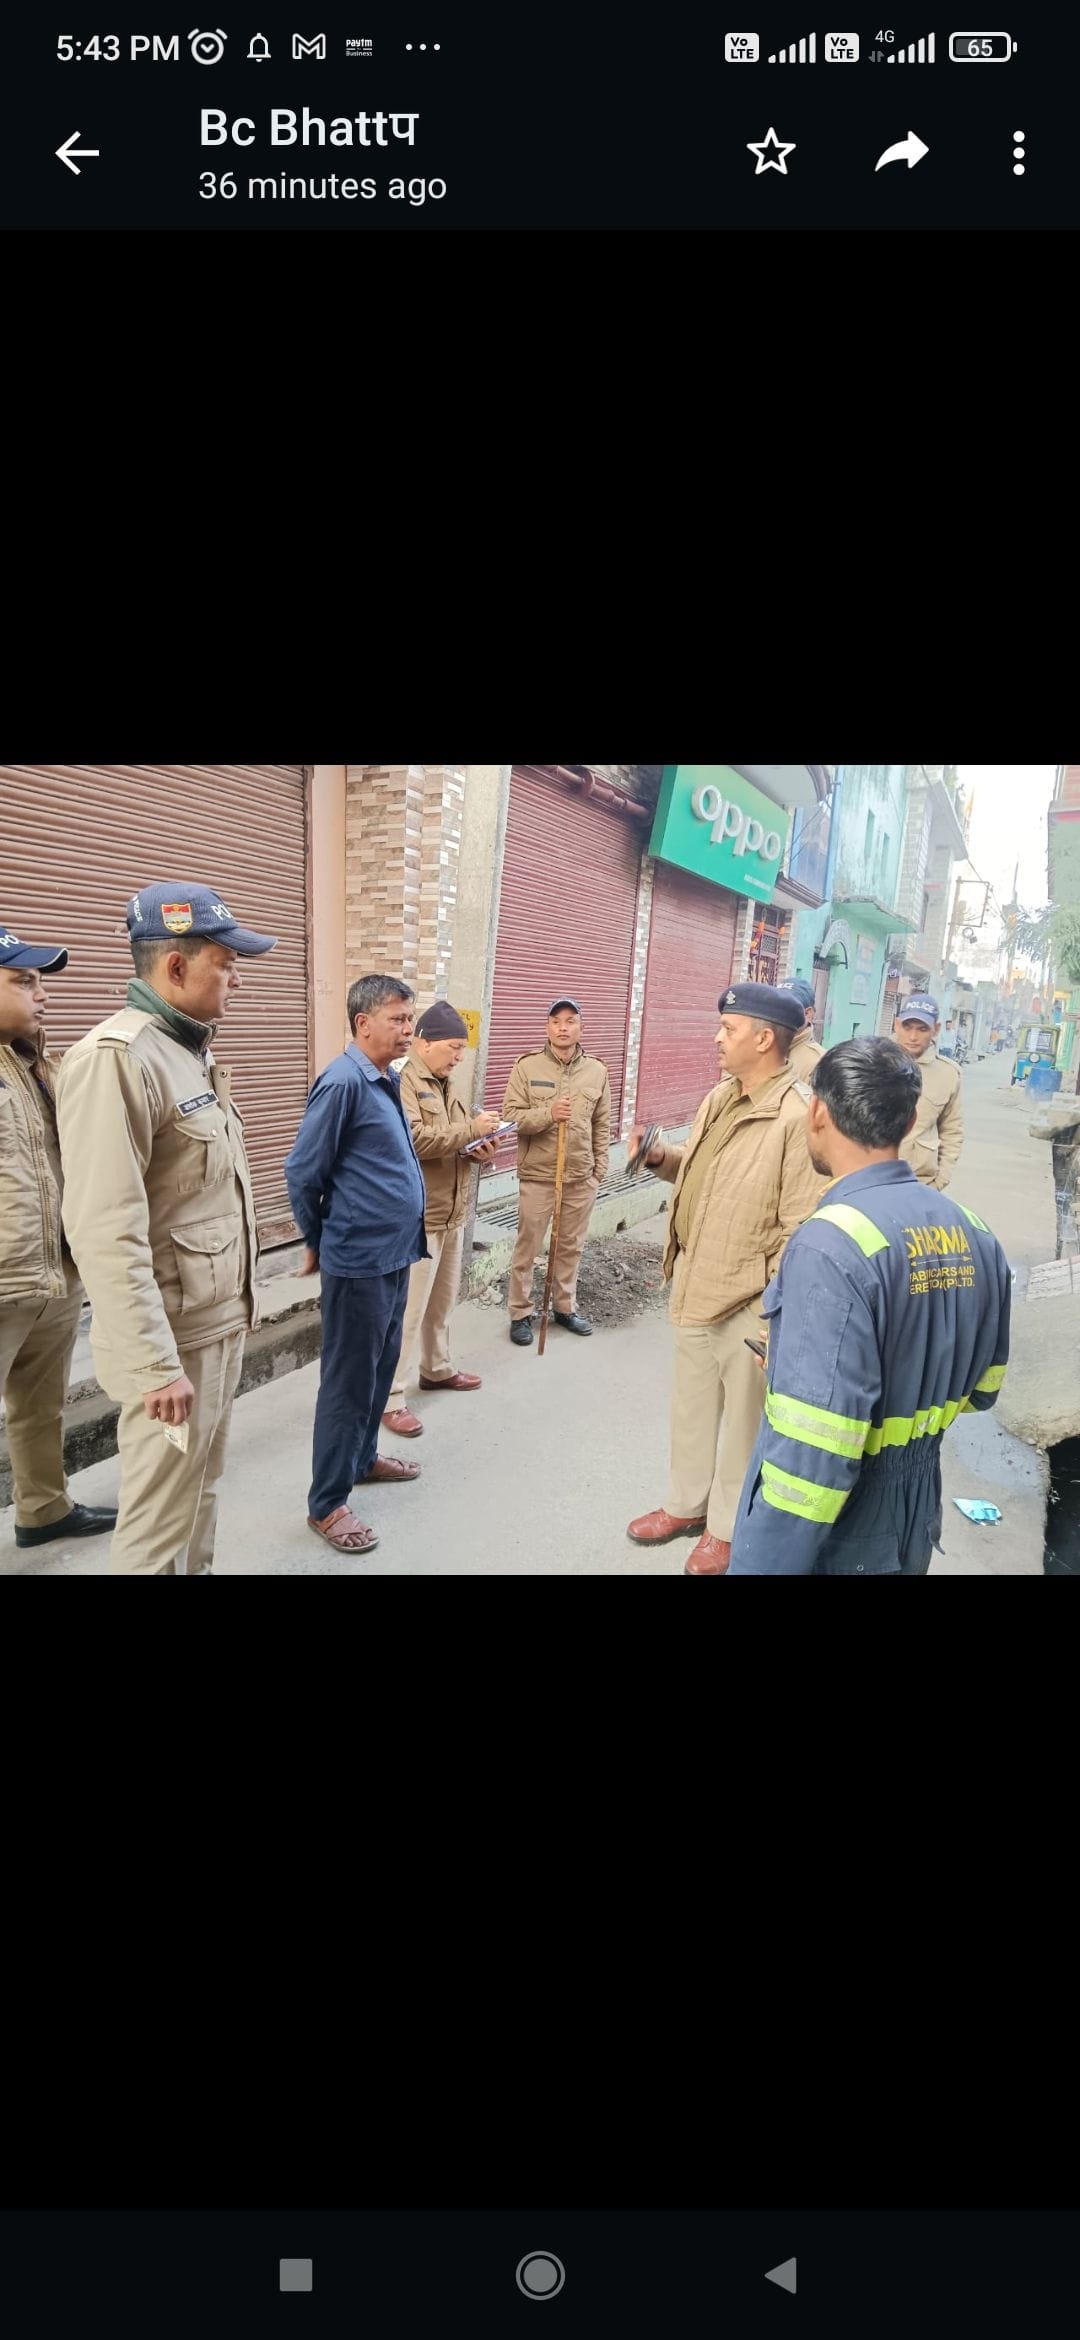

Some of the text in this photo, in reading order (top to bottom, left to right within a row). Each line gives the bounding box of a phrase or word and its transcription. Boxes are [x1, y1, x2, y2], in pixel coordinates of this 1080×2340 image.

[731, 37, 748, 47] Vo
[831, 37, 848, 47] Vo
[875, 30, 895, 43] 4G
[57, 35, 179, 61] 5:43 PM
[731, 49, 754, 59] LTE
[831, 49, 854, 59] LTE
[967, 39, 993, 57] 65
[201, 109, 255, 146] Bc
[199, 172, 447, 206] 36 minutes ago
[691, 784, 781, 861] oppo
